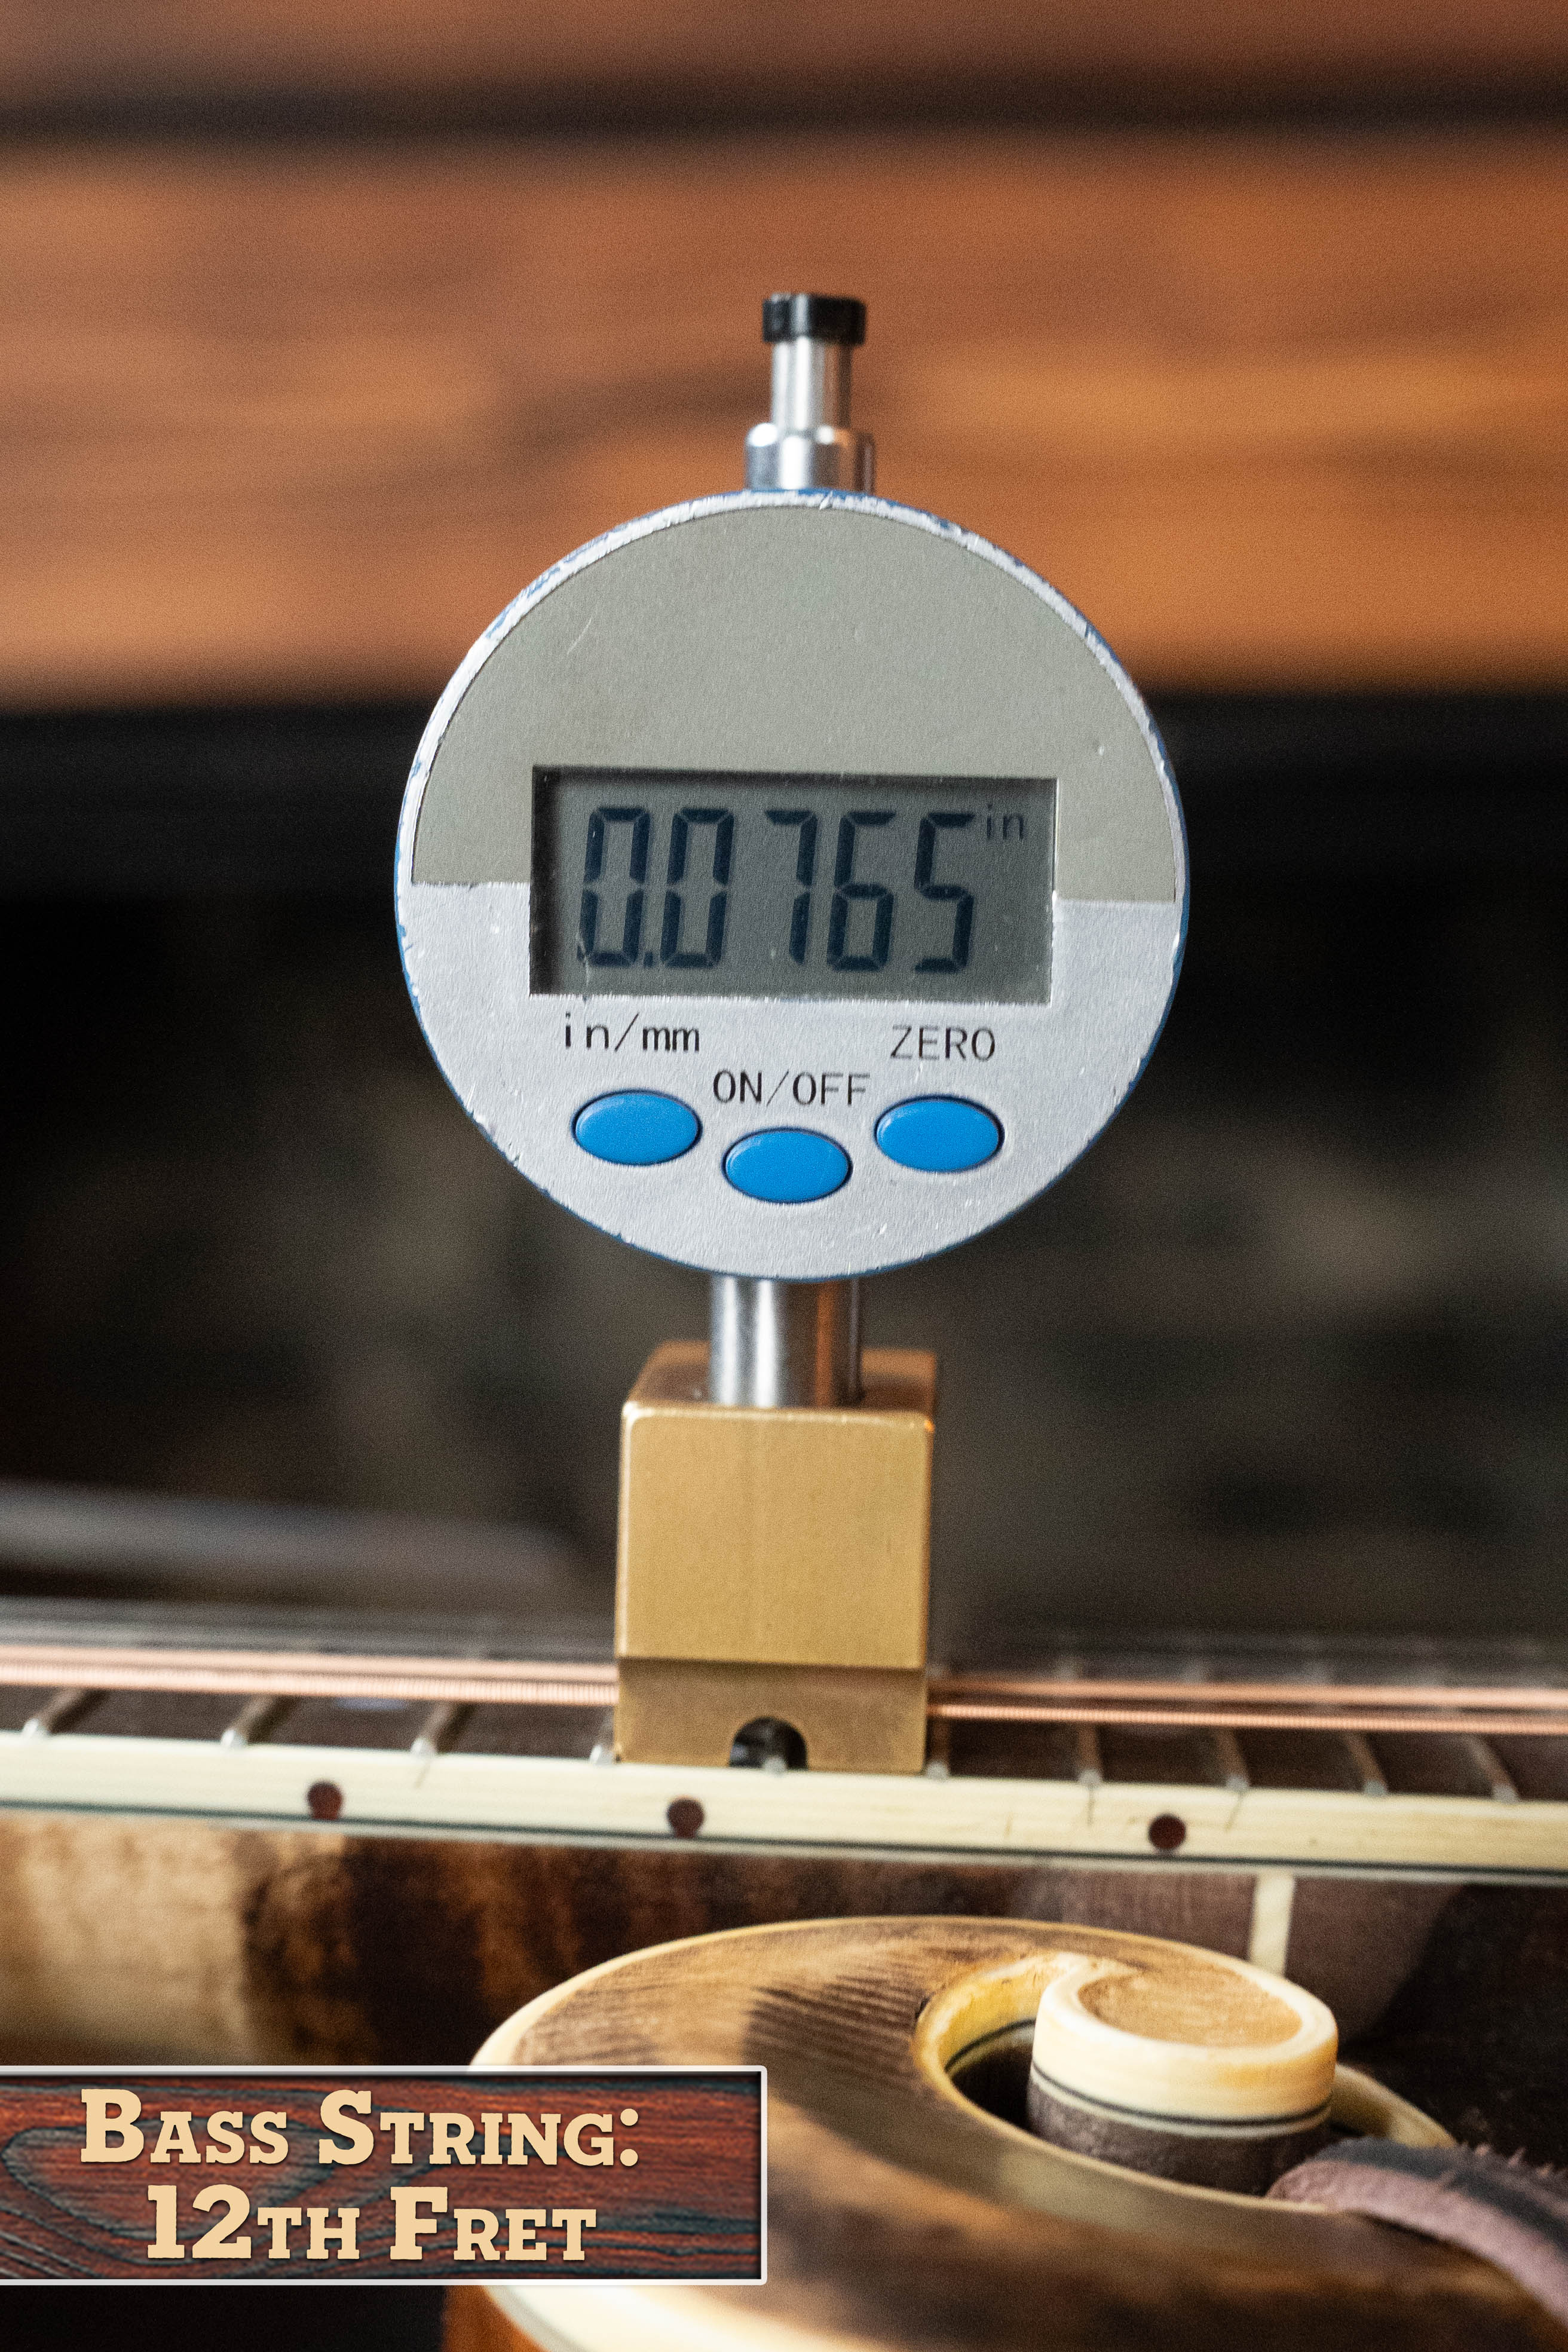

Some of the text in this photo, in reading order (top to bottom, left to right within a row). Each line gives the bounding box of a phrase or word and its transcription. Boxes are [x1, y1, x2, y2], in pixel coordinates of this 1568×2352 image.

[577, 804, 1028, 974] 0.0765 in
[564, 1011, 701, 1054] in/mm
[889, 1024, 996, 1062] ZERO
[712, 1070, 871, 1107] ON/OFF
